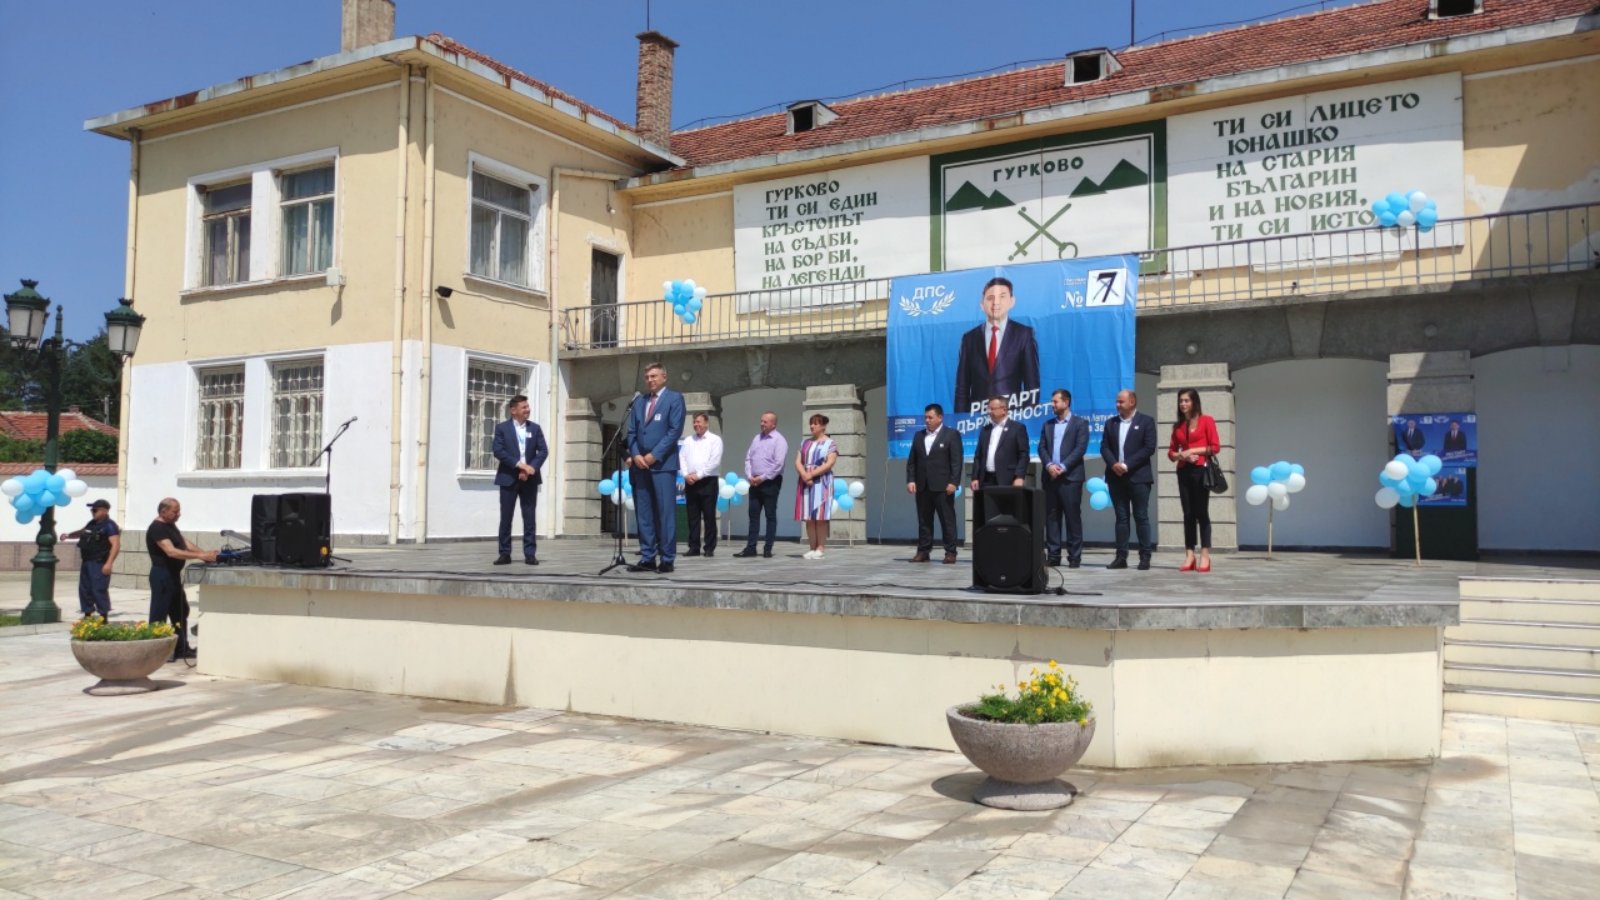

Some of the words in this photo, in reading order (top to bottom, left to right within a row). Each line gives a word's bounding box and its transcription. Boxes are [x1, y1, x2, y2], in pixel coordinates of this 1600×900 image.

[1213, 117, 1245, 137] ТИ
[1261, 110, 1291, 130] СИ
[1309, 92, 1420, 123] ЛИЦЕТО
[1228, 126, 1339, 156] ЮНАШКО
[993, 156, 1084, 182] ГУРКОВО
[1217, 160, 1247, 179] НА
[1262, 145, 1356, 172] СТАРИЯ
[766, 180, 840, 204] ГУРКОВО
[1227, 167, 1357, 198] БЪЛГАРИН
[766, 205, 788, 220] ТИ
[797, 201, 818, 216] СИ
[829, 192, 878, 211] ЕДИН
[1209, 205, 1224, 221] И
[1234, 199, 1266, 218] НА
[1275, 189, 1368, 212] НОВИЯ,
[762, 212, 864, 238] КРЪСТОПЪТ
[1211, 223, 1242, 241] ТИ
[1258, 217, 1290, 236] СИ
[1311, 209, 1376, 231] ИСТО
[765, 241, 785, 256] НА
[791, 231, 859, 251] СЪДБИ,
[762, 275, 782, 290] НА
[788, 265, 865, 285] ЛЕГЕНДИ
[765, 258, 786, 272] НА
[912, 285, 946, 301] ДПС
[1061, 291, 1083, 309] №
[1096, 271, 1118, 303] 7
[970, 388, 1040, 417] РЕАРТ
